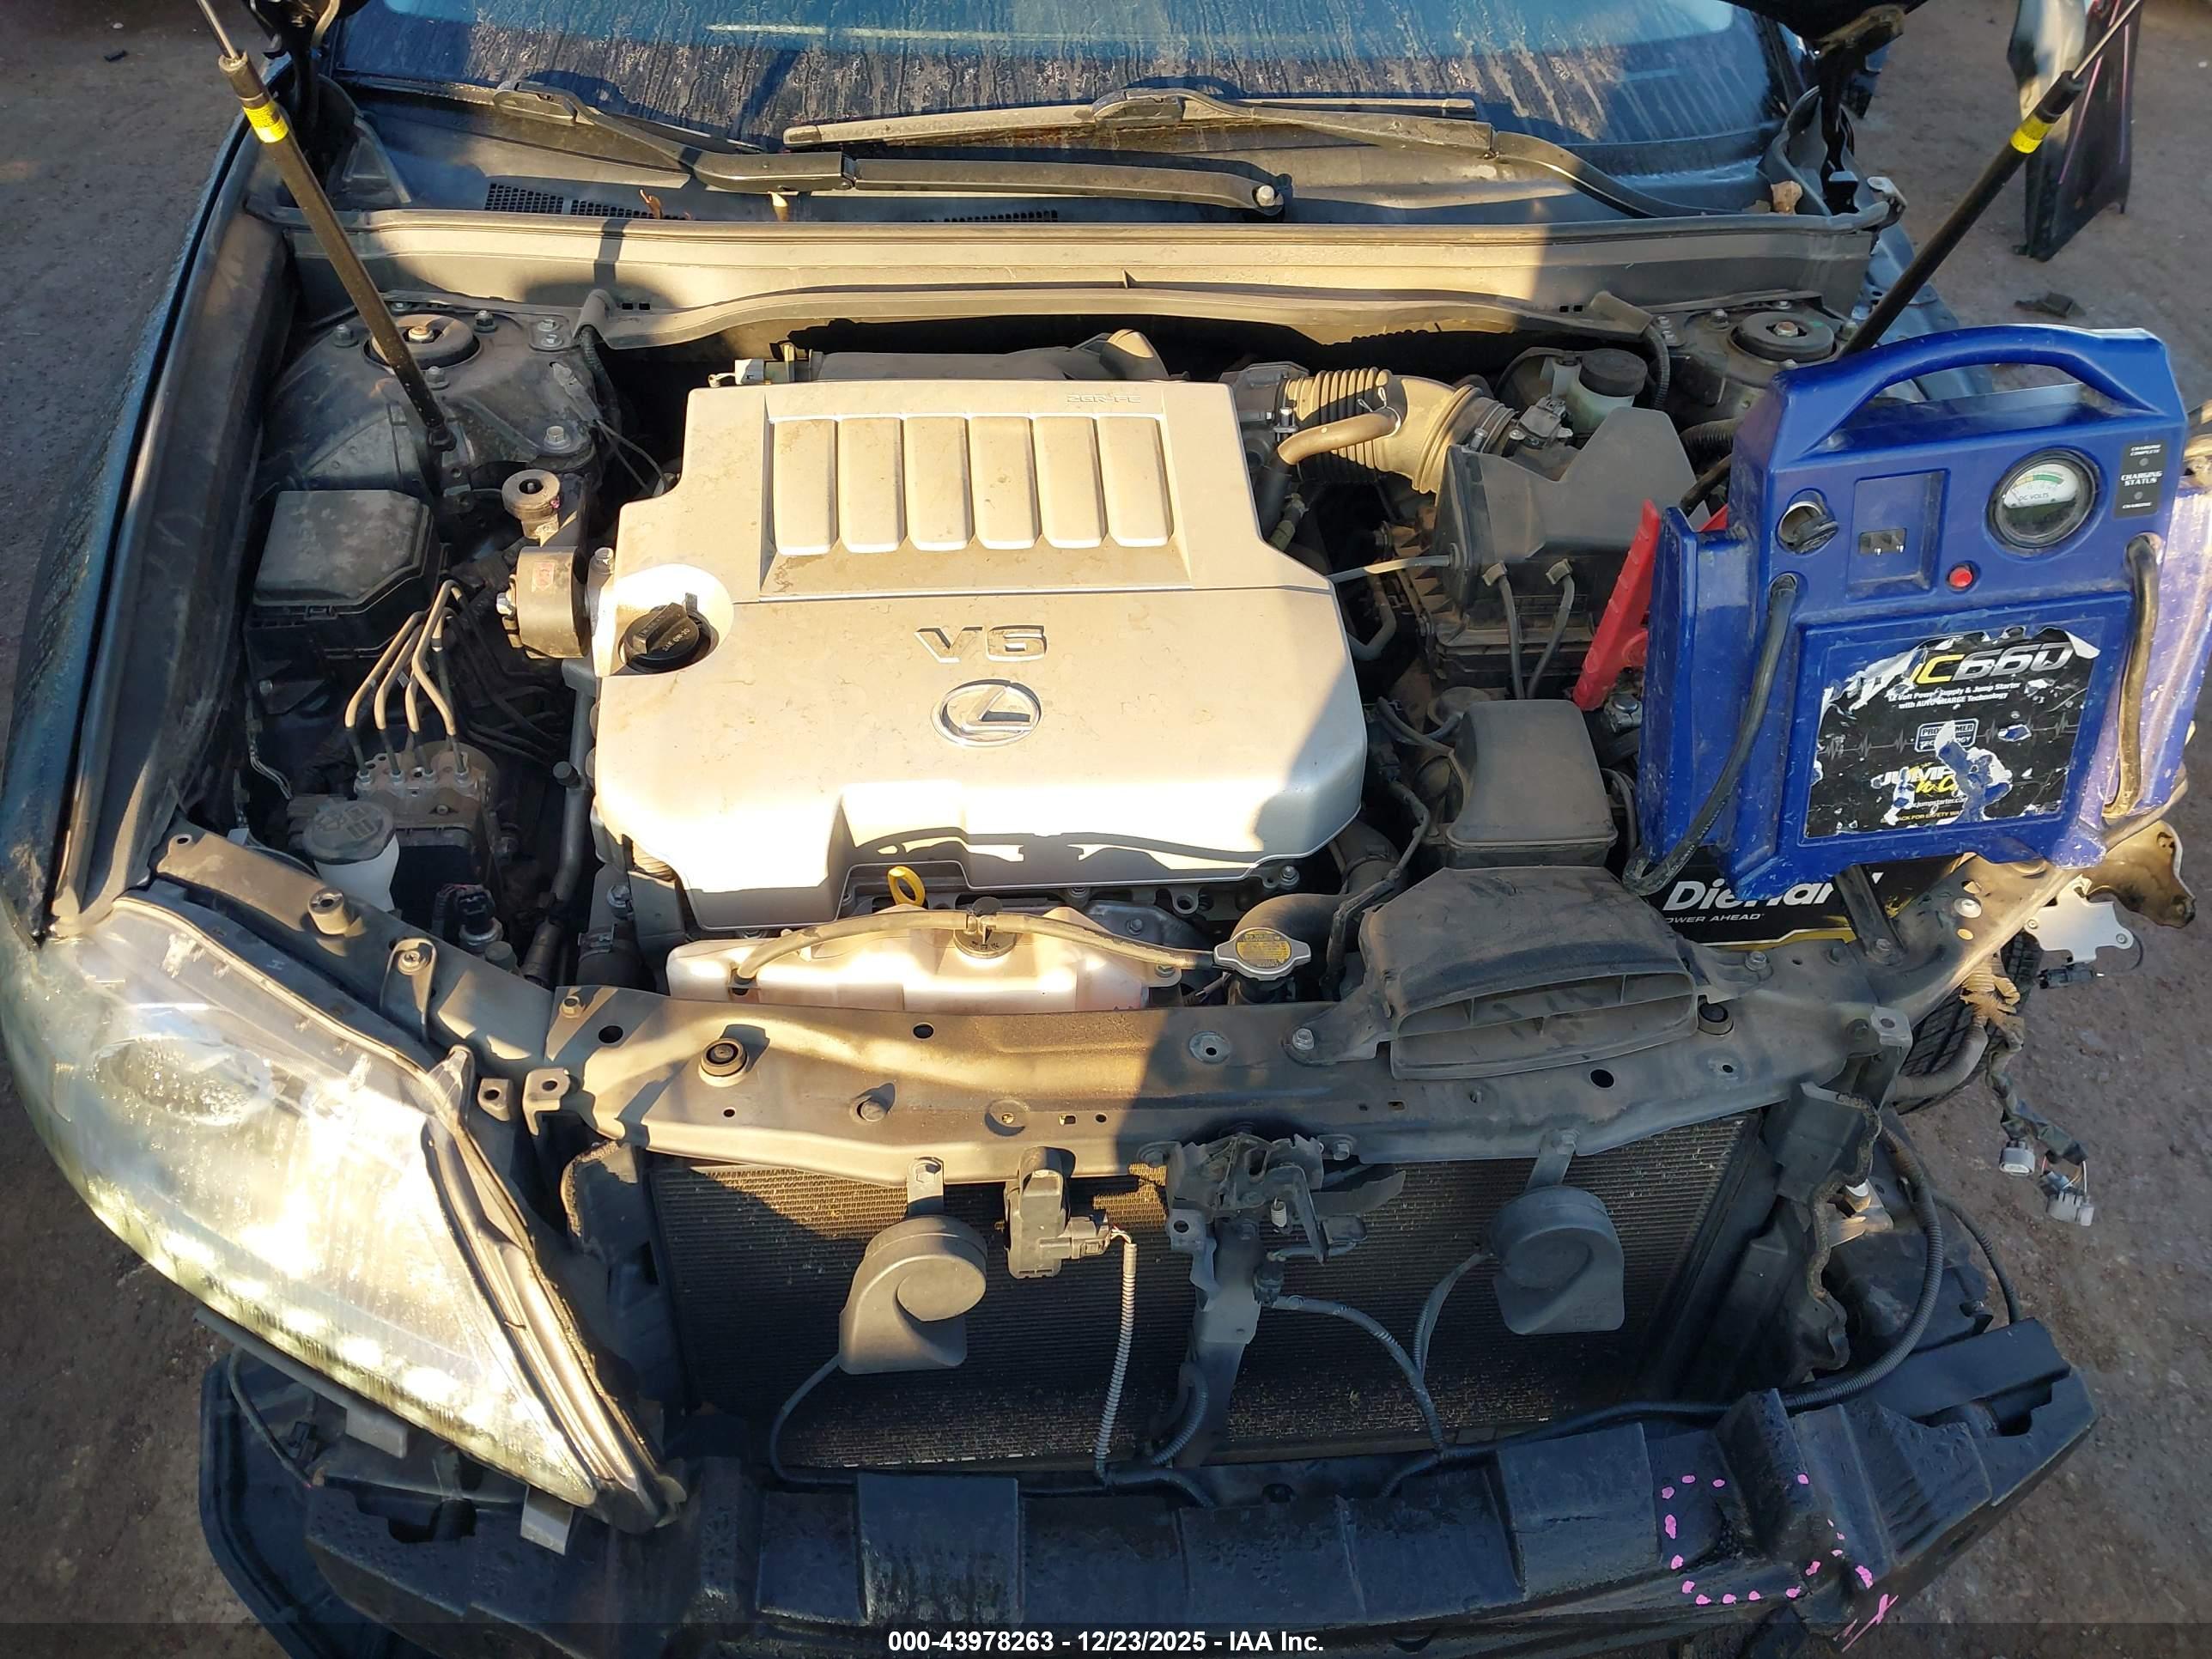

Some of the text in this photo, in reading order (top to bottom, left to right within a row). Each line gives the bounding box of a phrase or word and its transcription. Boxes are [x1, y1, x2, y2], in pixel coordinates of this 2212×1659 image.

[2120, 471, 2163, 481] CHARGING
[2124, 477, 2158, 487] STATUS
[914, 624, 1048, 664] V6
[1910, 642, 2076, 685] C660
[1972, 684, 1994, 694] Jump
[1995, 682, 2021, 691] Starter
[1898, 701, 1916, 709] with
[1967, 691, 2009, 702] Technology
[1922, 724, 1974, 736] PROMER
[1665, 913, 1761, 924] OWER AHEAD
